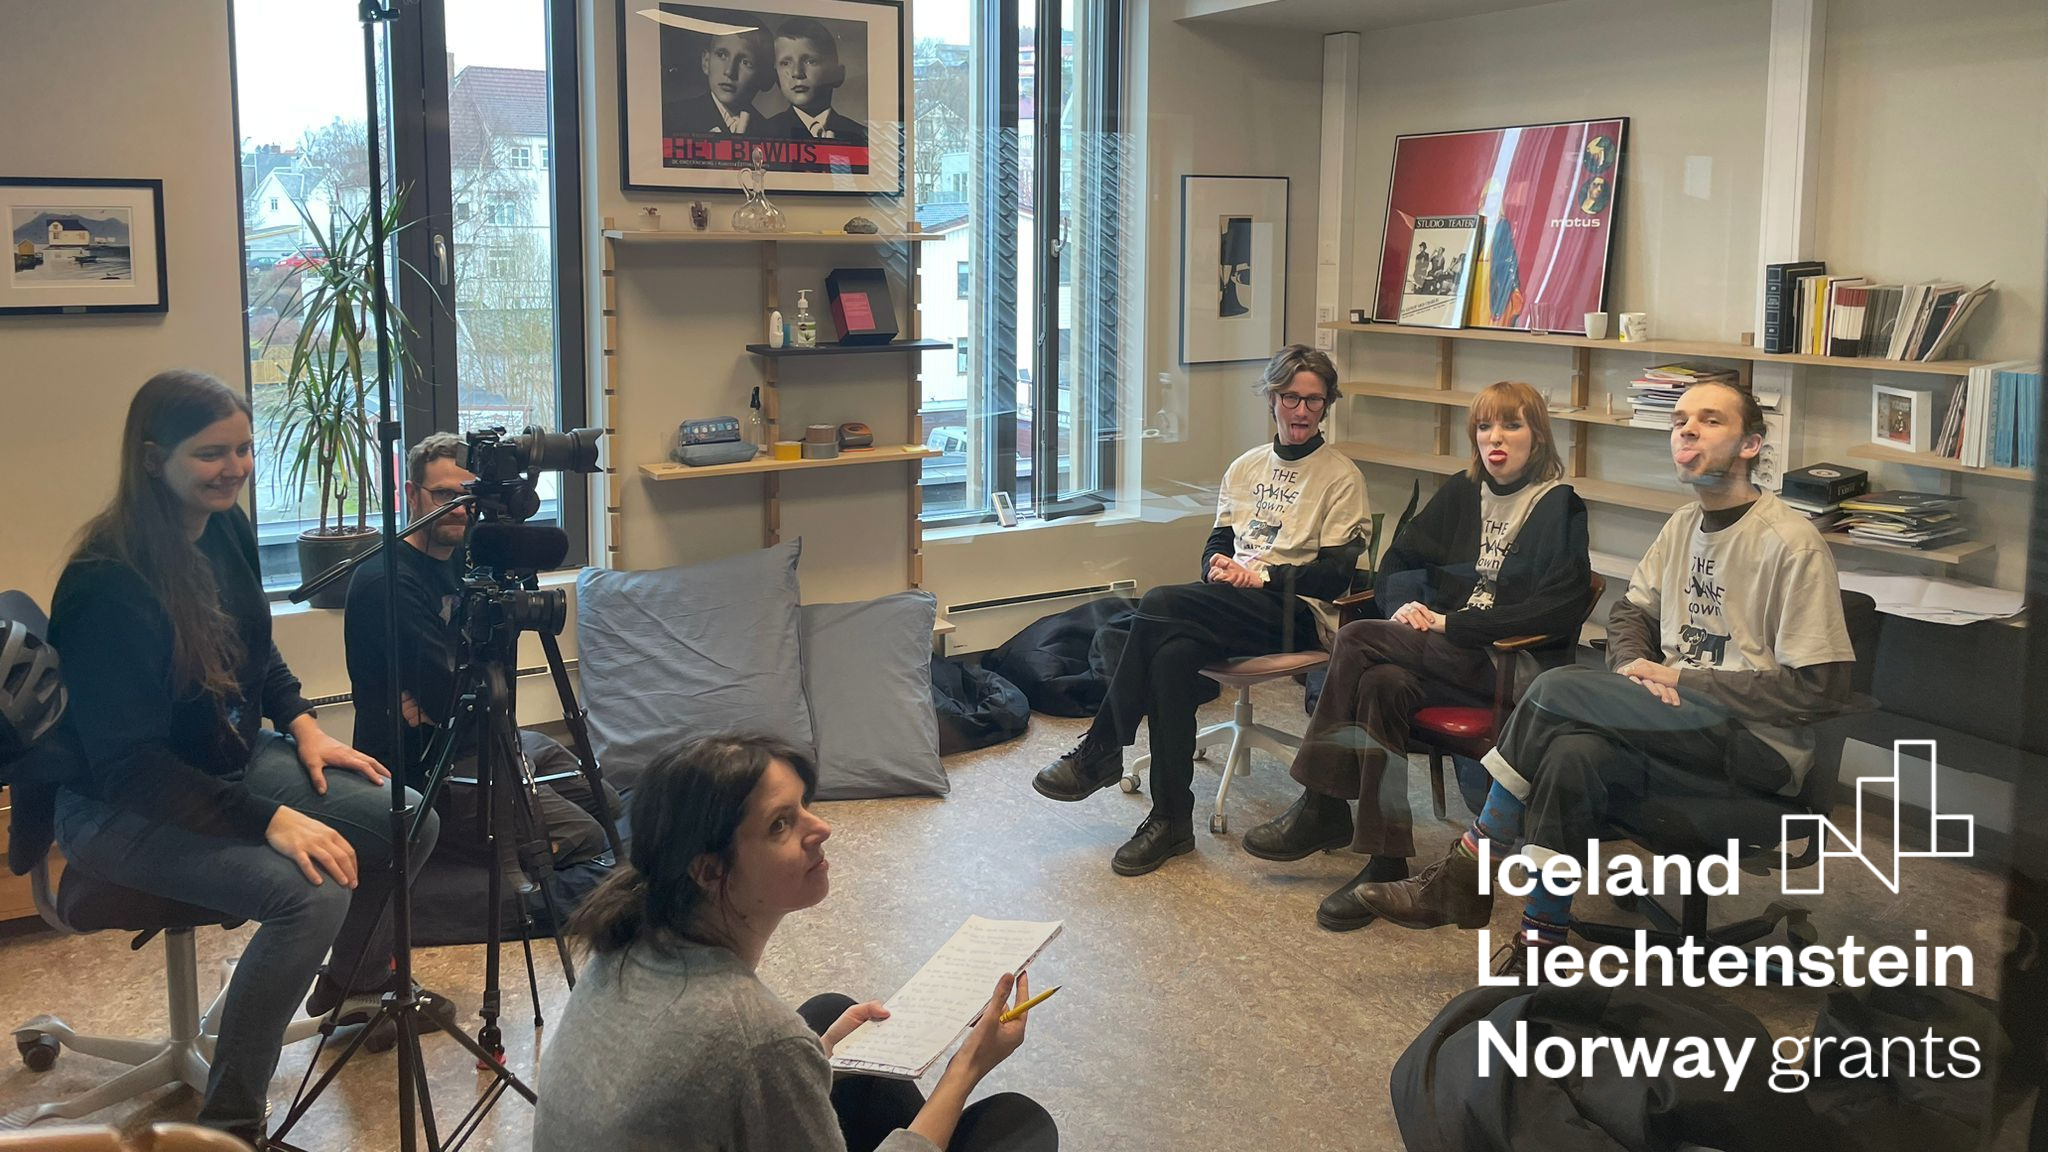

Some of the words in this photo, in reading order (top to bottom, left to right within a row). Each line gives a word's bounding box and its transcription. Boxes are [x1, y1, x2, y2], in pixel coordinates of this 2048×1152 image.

[672, 139, 719, 161] HET
[1416, 219, 1445, 228] STUDIO
[1448, 218, 1475, 228] TEATER
[1550, 217, 1601, 228] motus
[1272, 468, 1299, 484] THE
[1252, 482, 1300, 505] SHAKE
[1485, 520, 1509, 536] THE
[1477, 558, 1500, 570] own
